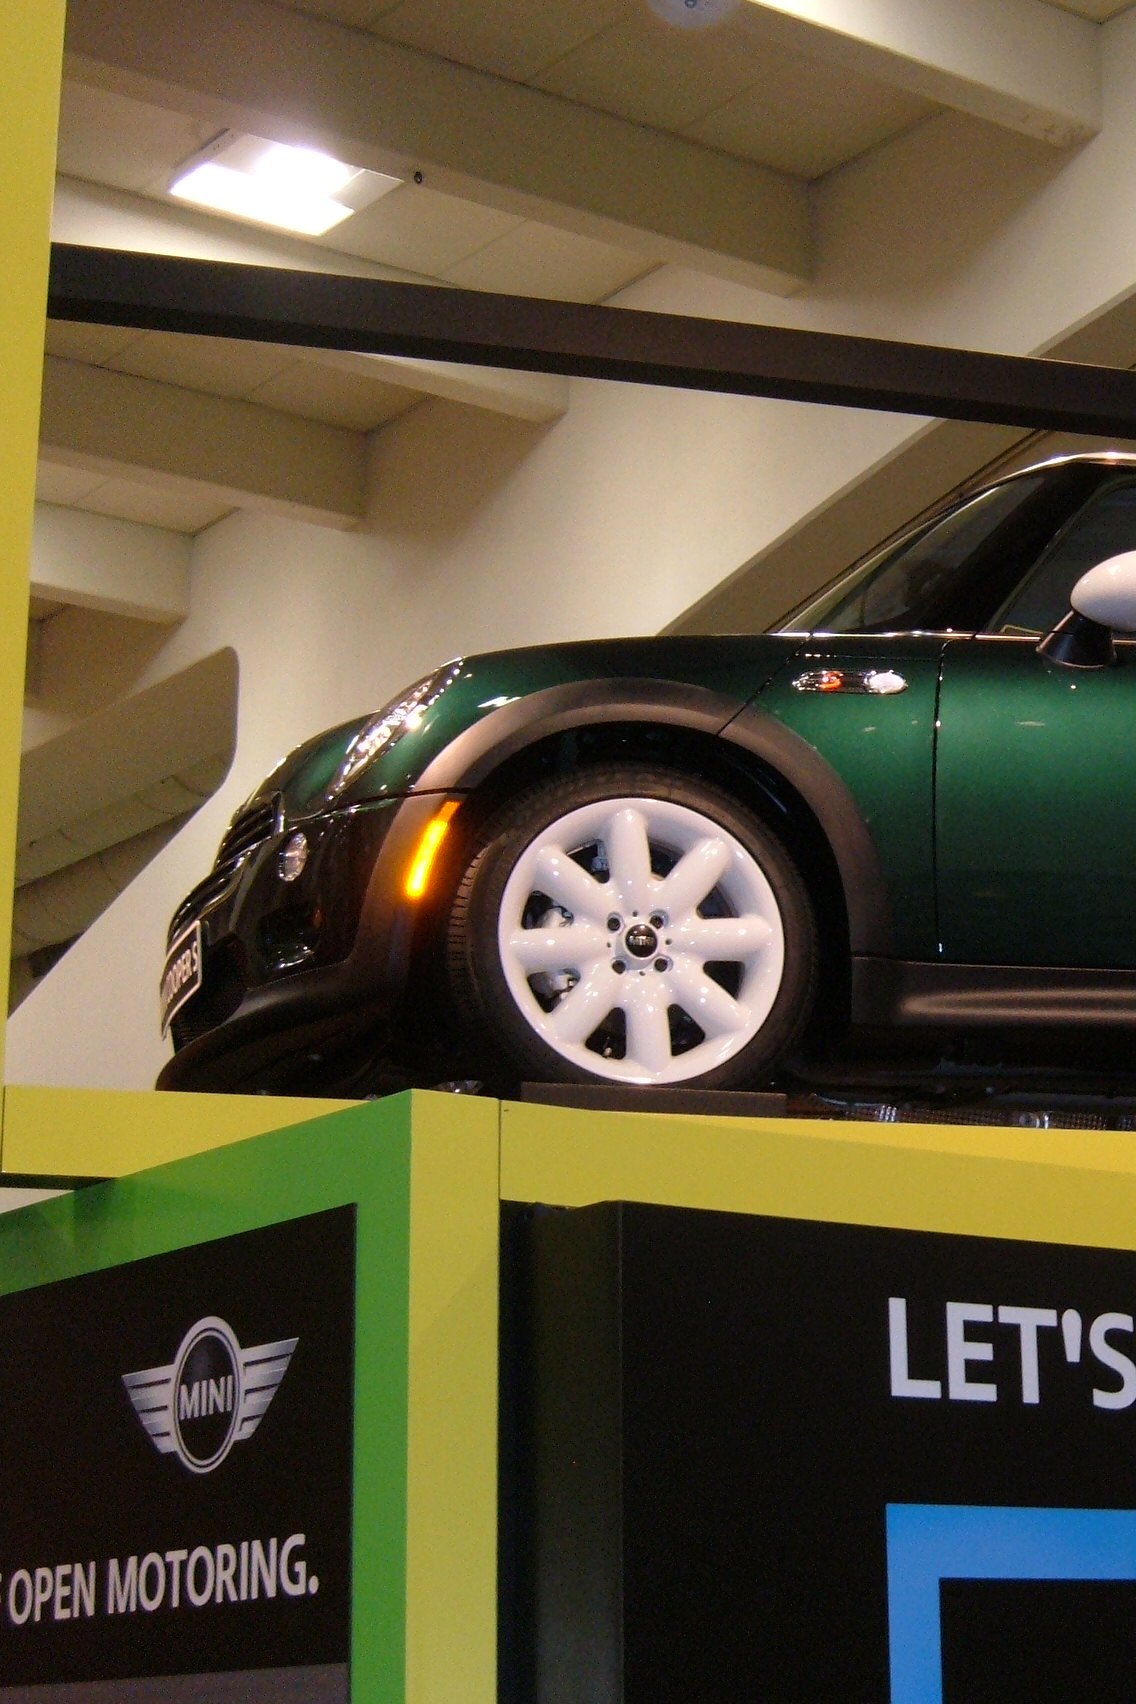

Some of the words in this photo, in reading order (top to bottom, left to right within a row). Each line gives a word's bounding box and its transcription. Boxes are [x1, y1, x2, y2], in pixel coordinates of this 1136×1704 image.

[180, 1375, 233, 1420] MINI
[9, 1561, 96, 1624] OPEN
[108, 1534, 319, 1614] MOTORING.
